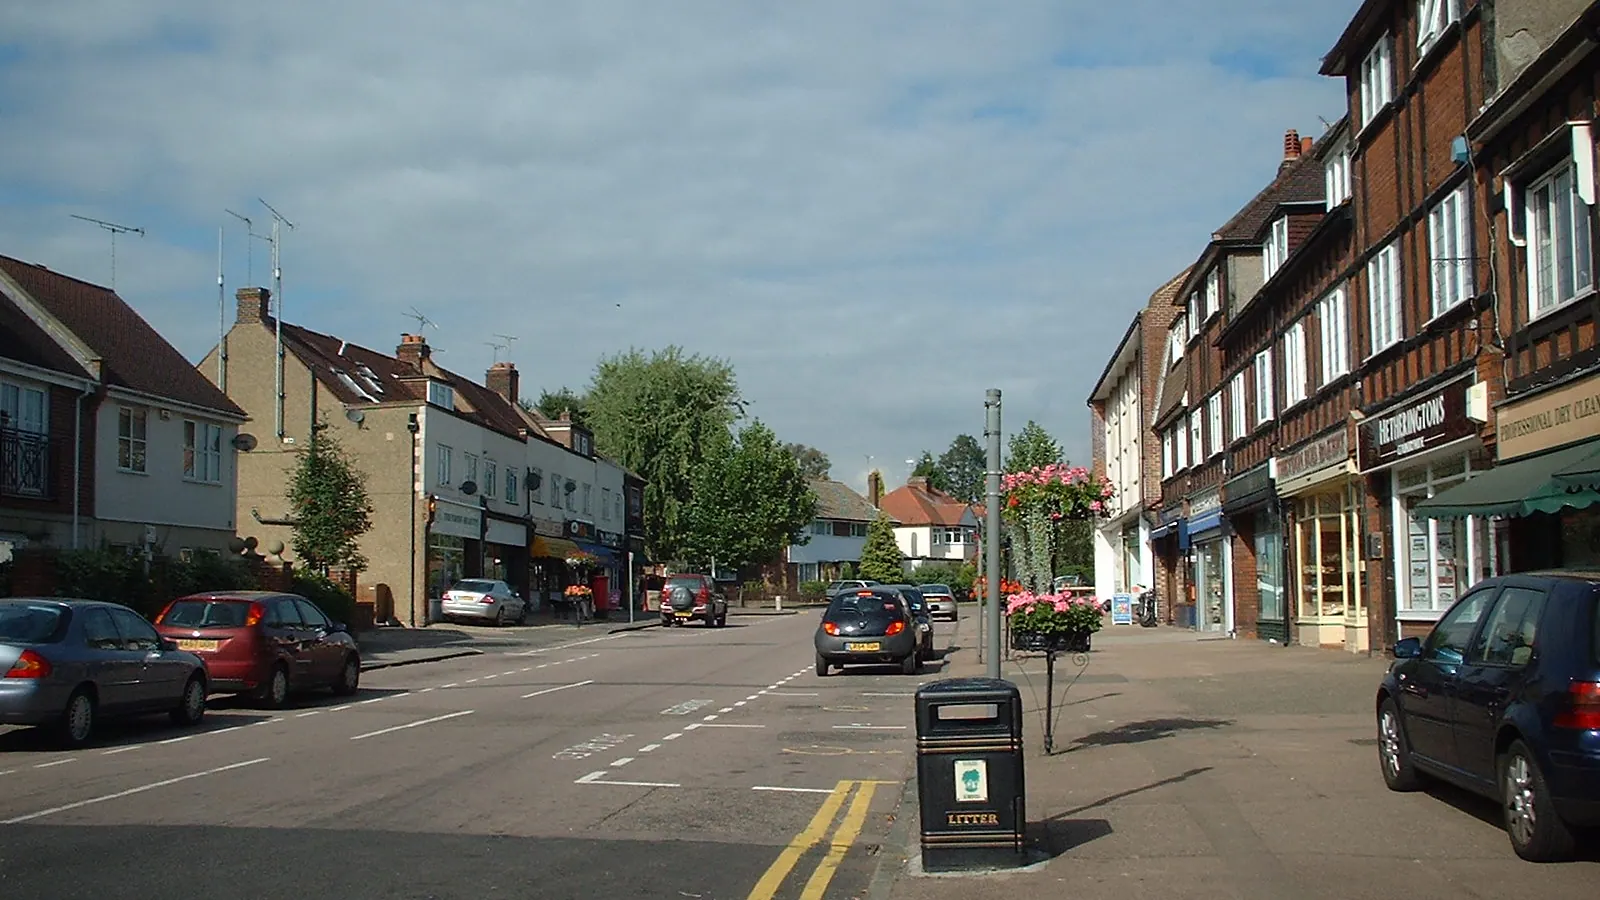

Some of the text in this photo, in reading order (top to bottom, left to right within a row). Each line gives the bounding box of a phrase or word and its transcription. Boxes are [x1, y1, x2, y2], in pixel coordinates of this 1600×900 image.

[1378, 395, 1445, 446] HETHERINGTONS
[1500, 411, 1553, 442] PROFESSIONAL
[1555, 404, 1571, 426] DRY
[947, 814, 998, 825] LITTER
